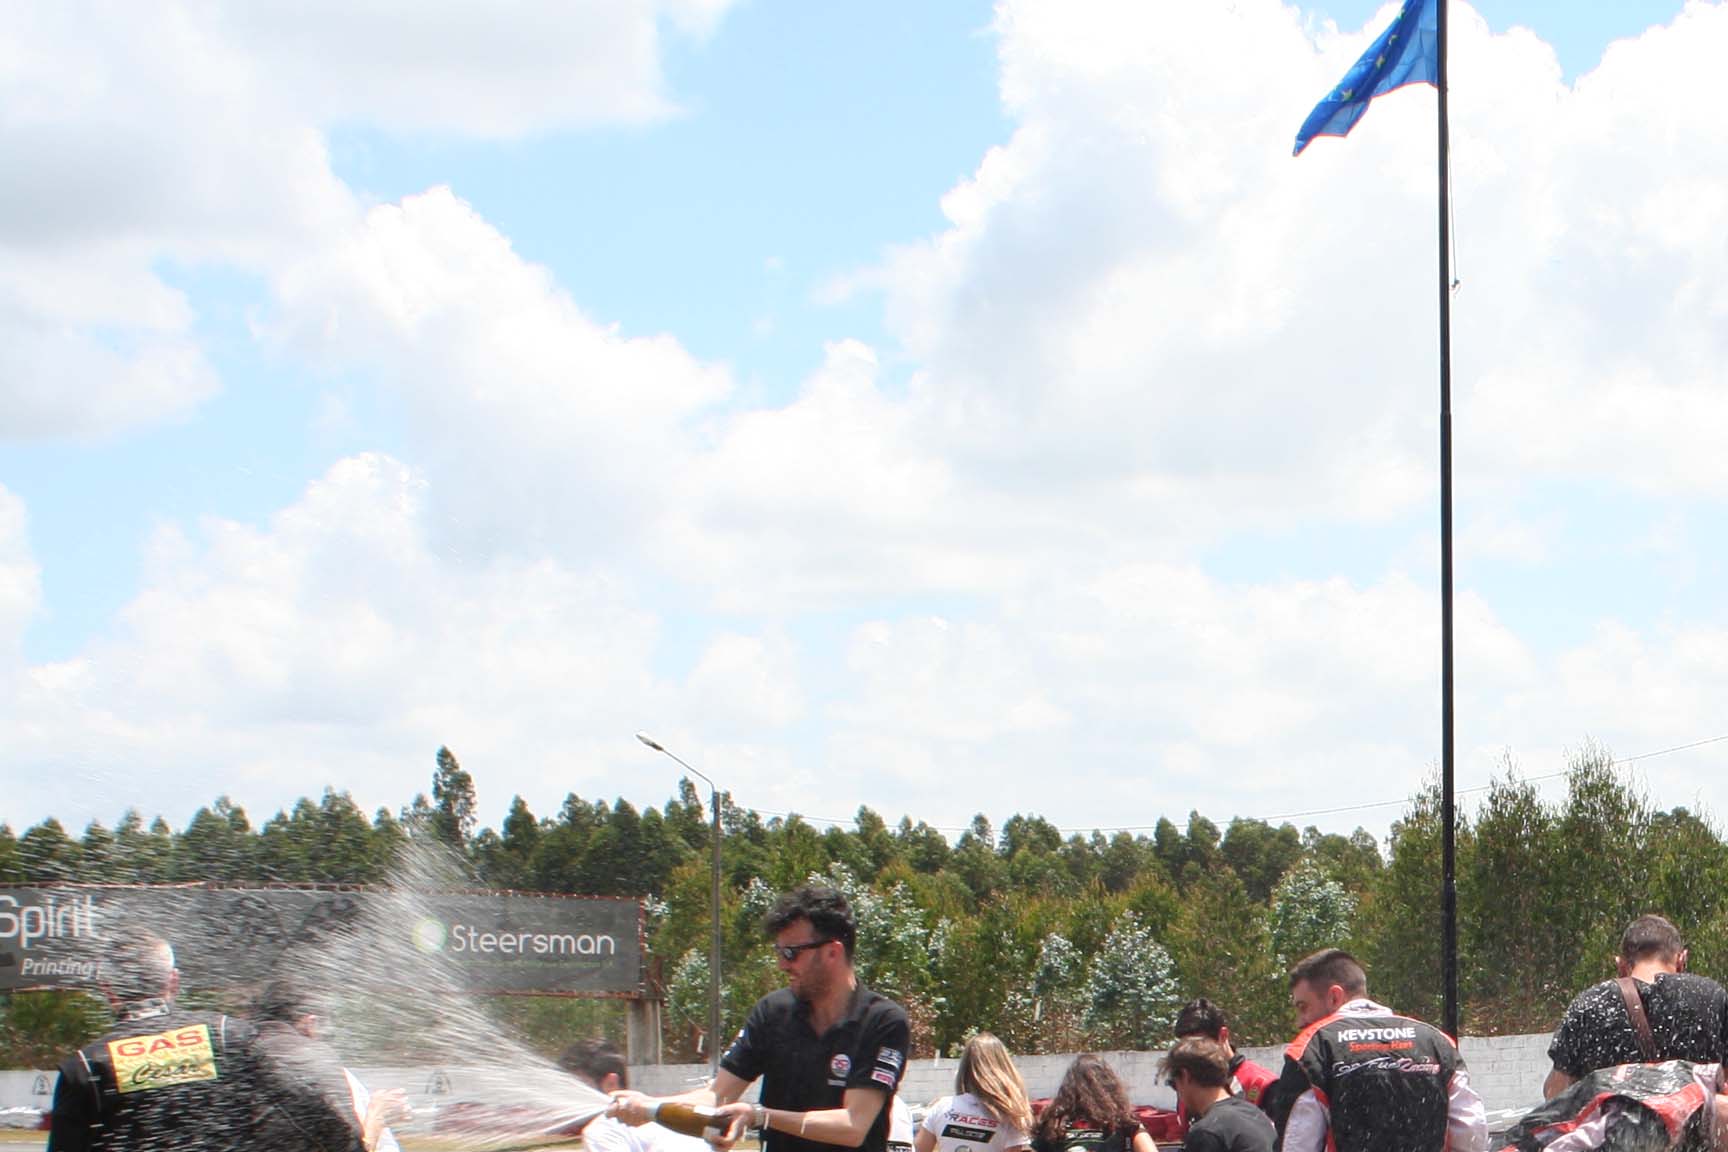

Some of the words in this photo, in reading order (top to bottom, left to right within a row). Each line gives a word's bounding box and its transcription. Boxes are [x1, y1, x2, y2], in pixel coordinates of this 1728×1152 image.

[452, 924, 615, 955] Steersman
[117, 1030, 204, 1057] GAS
[1338, 1028, 1416, 1042] KEYSTONE
